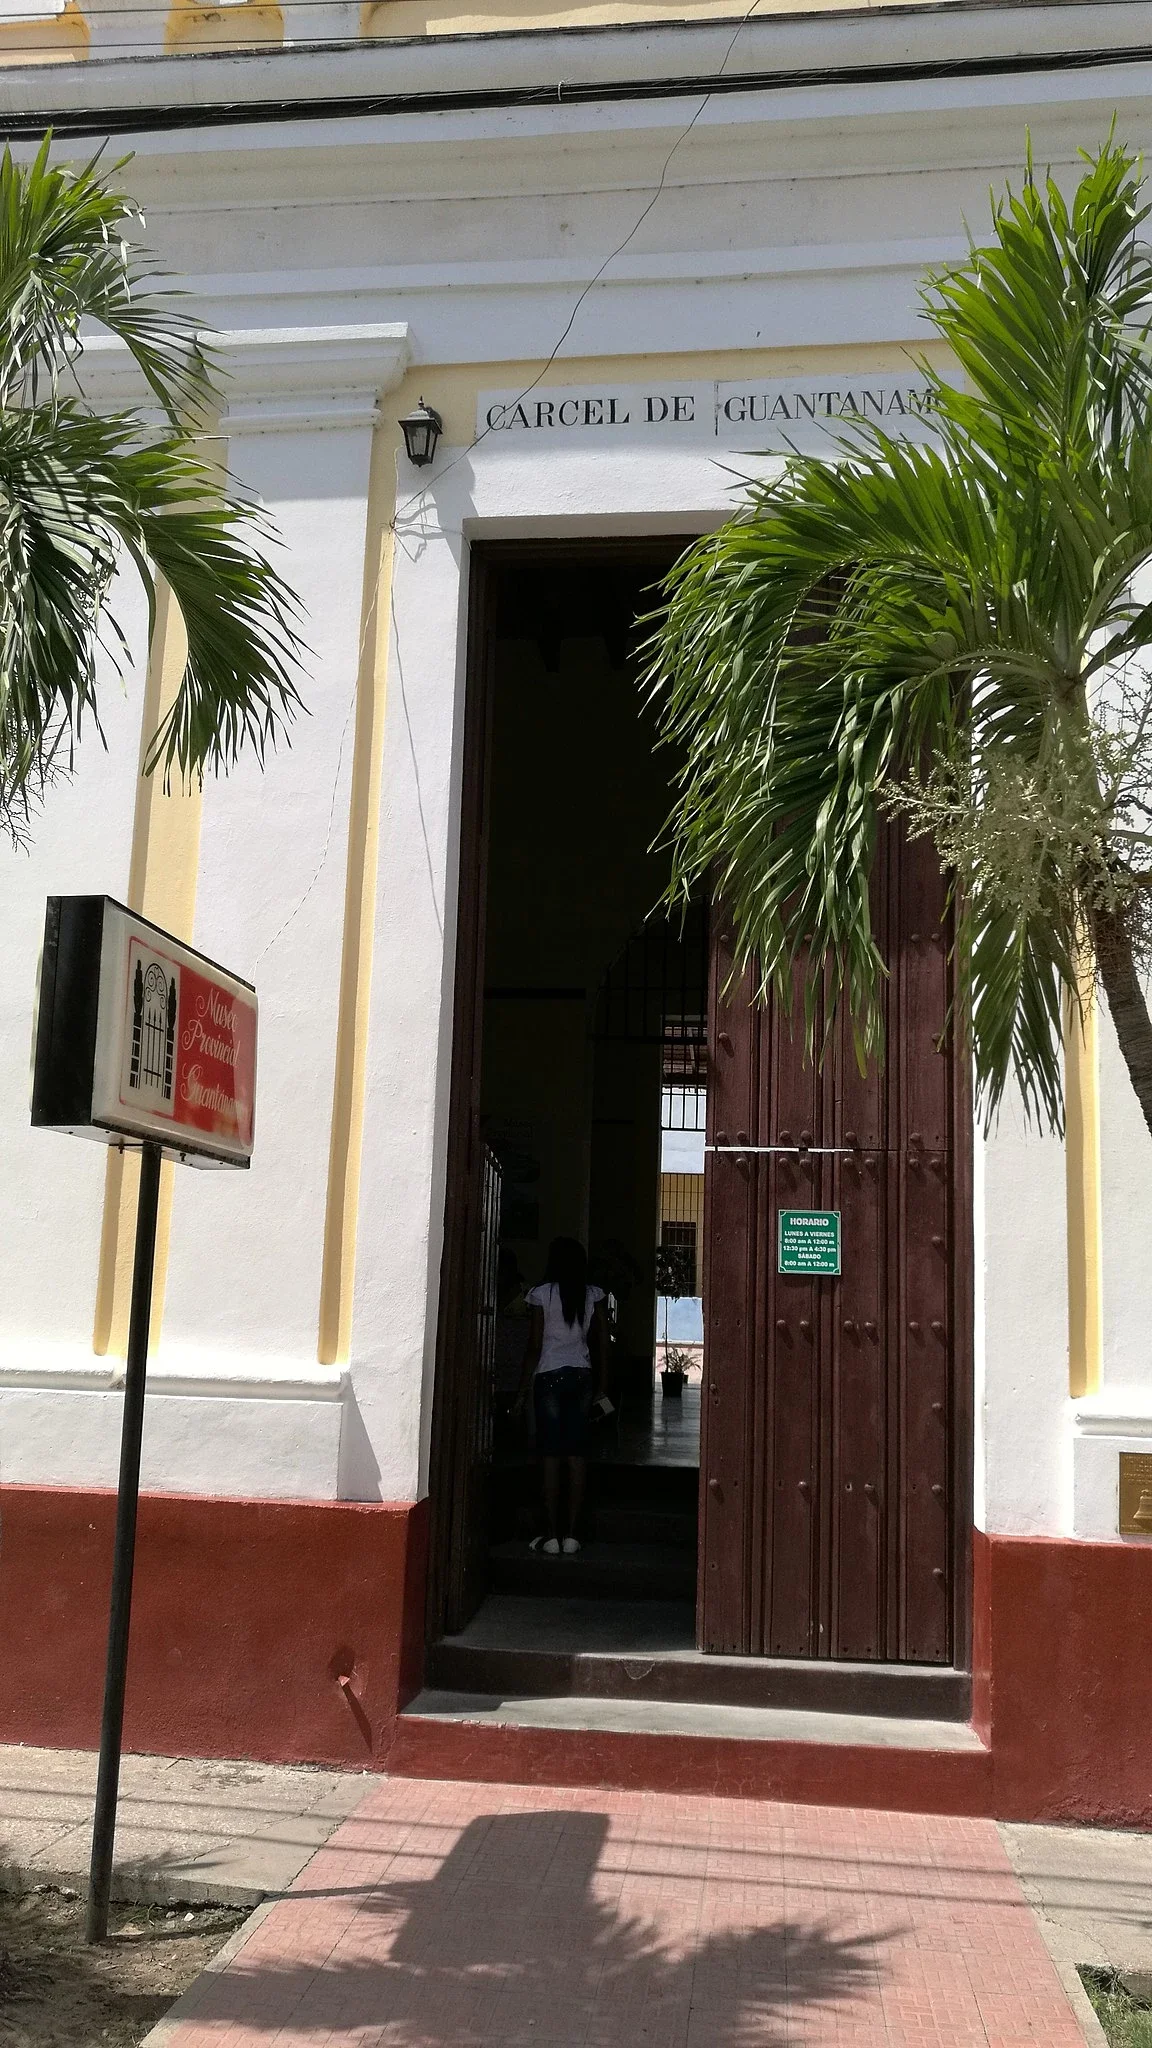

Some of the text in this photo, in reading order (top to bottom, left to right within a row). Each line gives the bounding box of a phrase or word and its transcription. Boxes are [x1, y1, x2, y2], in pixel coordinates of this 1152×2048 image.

[486, 388, 943, 431] CARCEL DE GUANTANAM
[181, 1019, 241, 1068] Provincial
[790, 1218, 829, 1226] HORARIO
